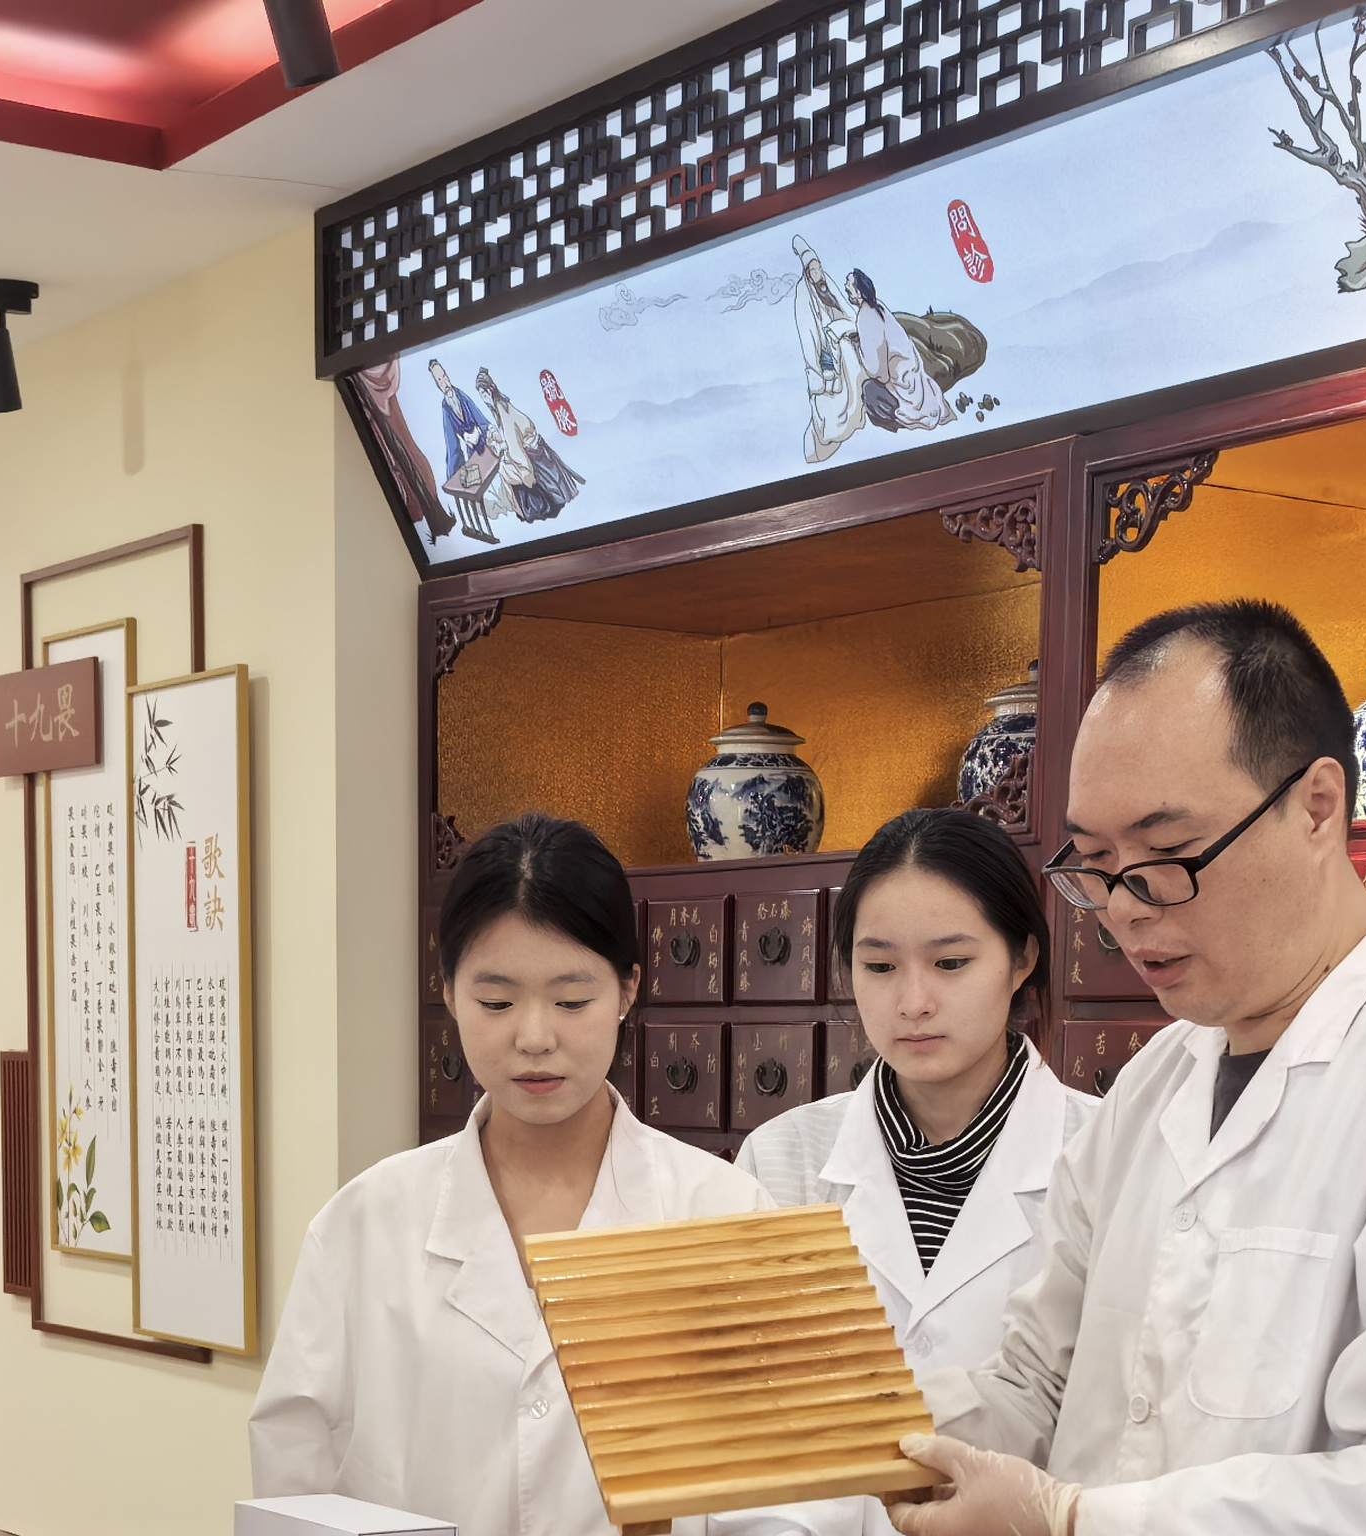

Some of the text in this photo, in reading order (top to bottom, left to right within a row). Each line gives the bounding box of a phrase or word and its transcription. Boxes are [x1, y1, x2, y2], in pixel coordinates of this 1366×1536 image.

[949, 204, 989, 279] 問診
[5, 683, 80, 749] 十九畏
[201, 832, 226, 932] 歌訣
